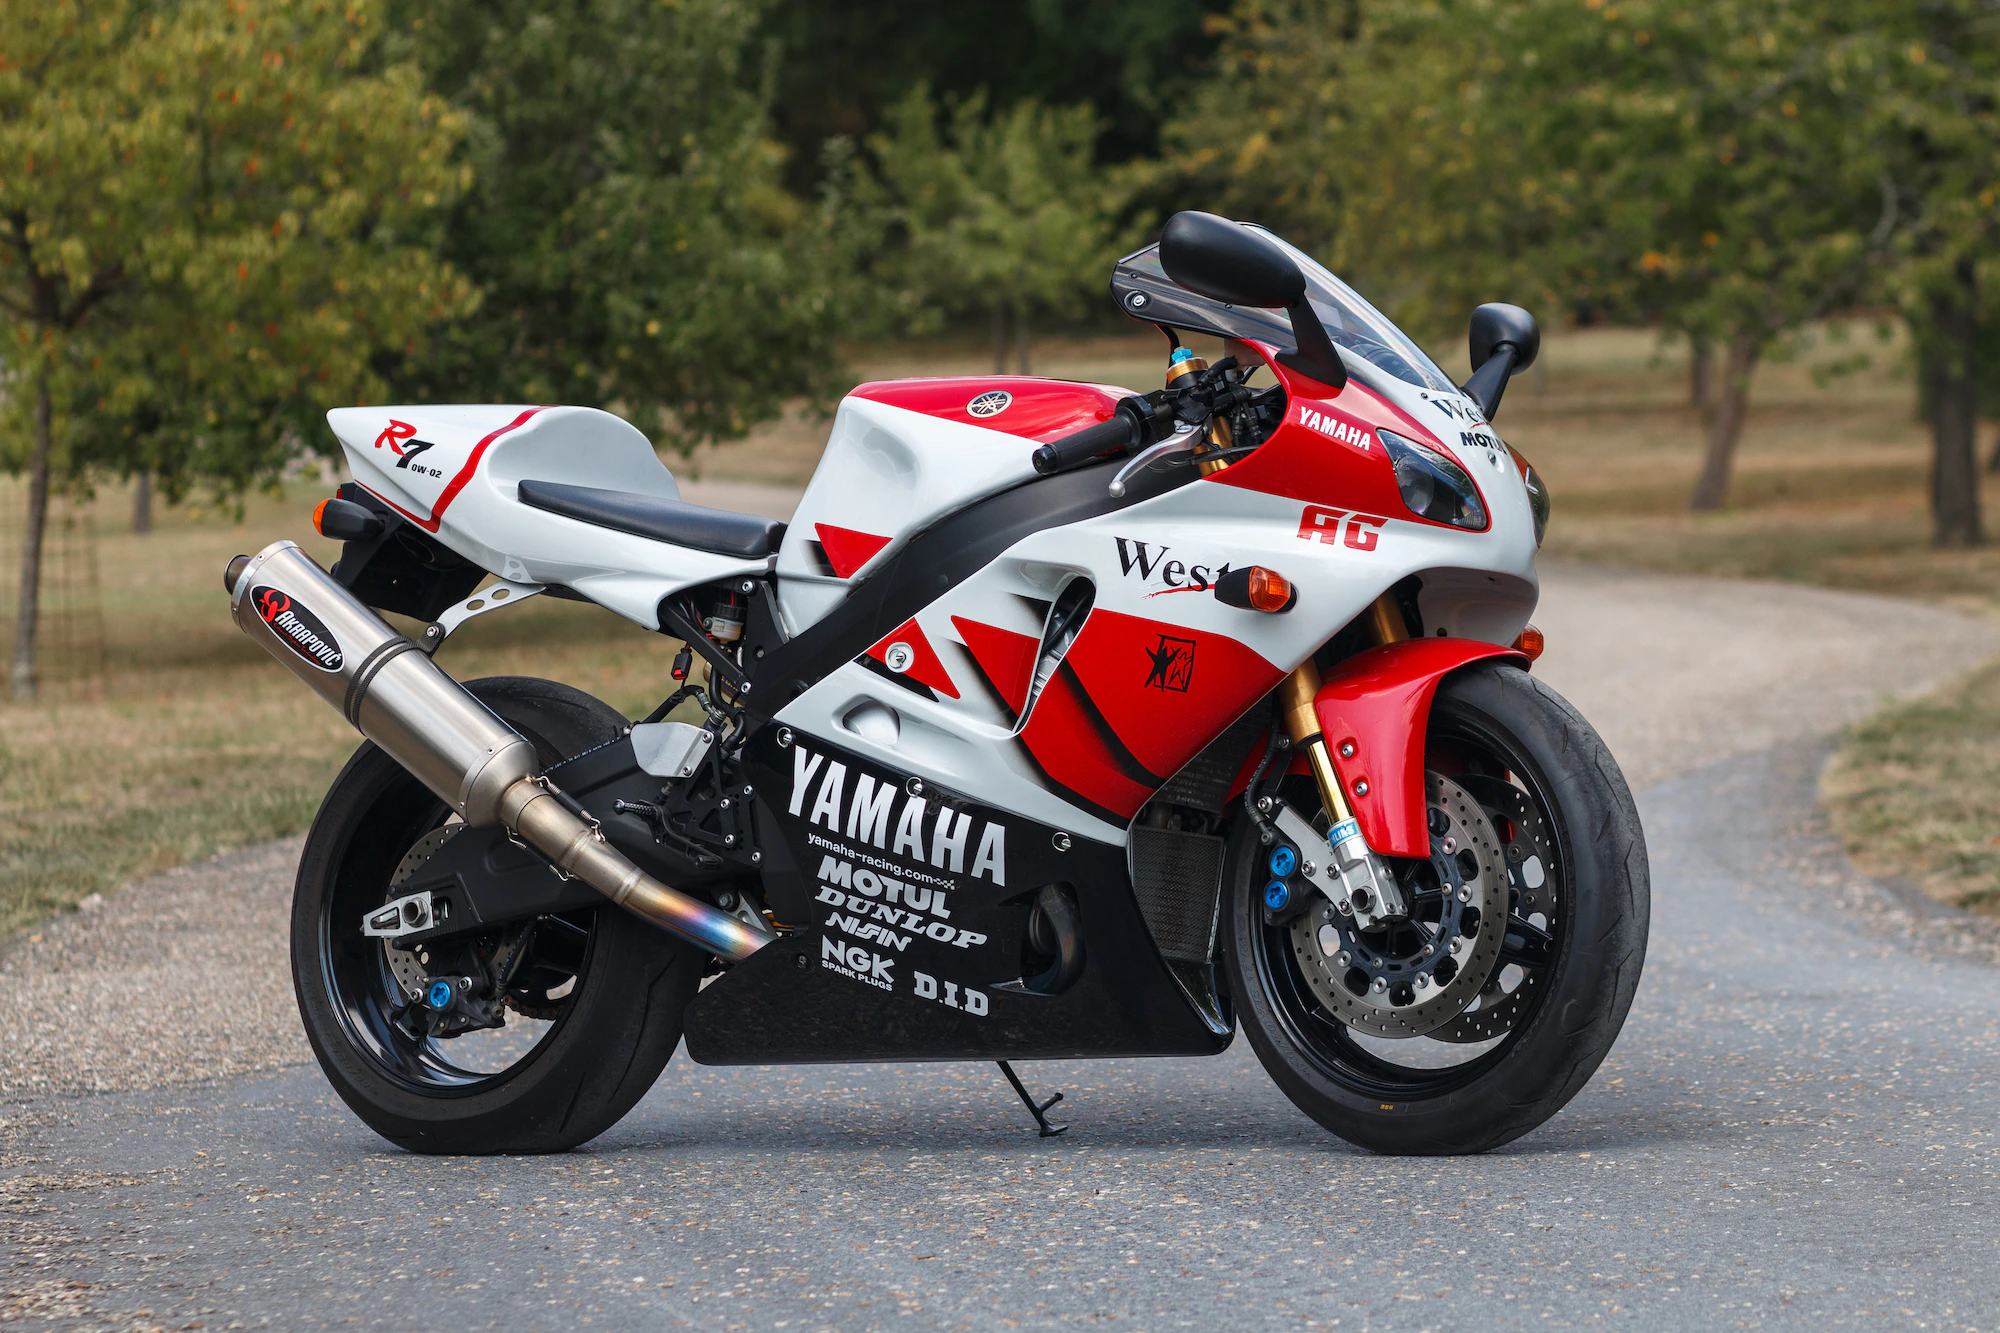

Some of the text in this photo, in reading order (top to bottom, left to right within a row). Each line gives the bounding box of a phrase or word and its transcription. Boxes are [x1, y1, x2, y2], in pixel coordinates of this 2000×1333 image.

[1300, 406, 1371, 451] YAMAHA
[1429, 399, 1486, 423] Wes
[374, 419, 435, 469] R7
[788, 745, 1005, 887] YAMAHA
[808, 832, 934, 883] yamaha-racing.com
[817, 855, 952, 919] MOTUL
[815, 886, 987, 949] DUNLOP
[821, 934, 895, 984] NGK
[822, 960, 893, 992] SPARK PLUGS
[913, 970, 989, 1017] D.I.D
